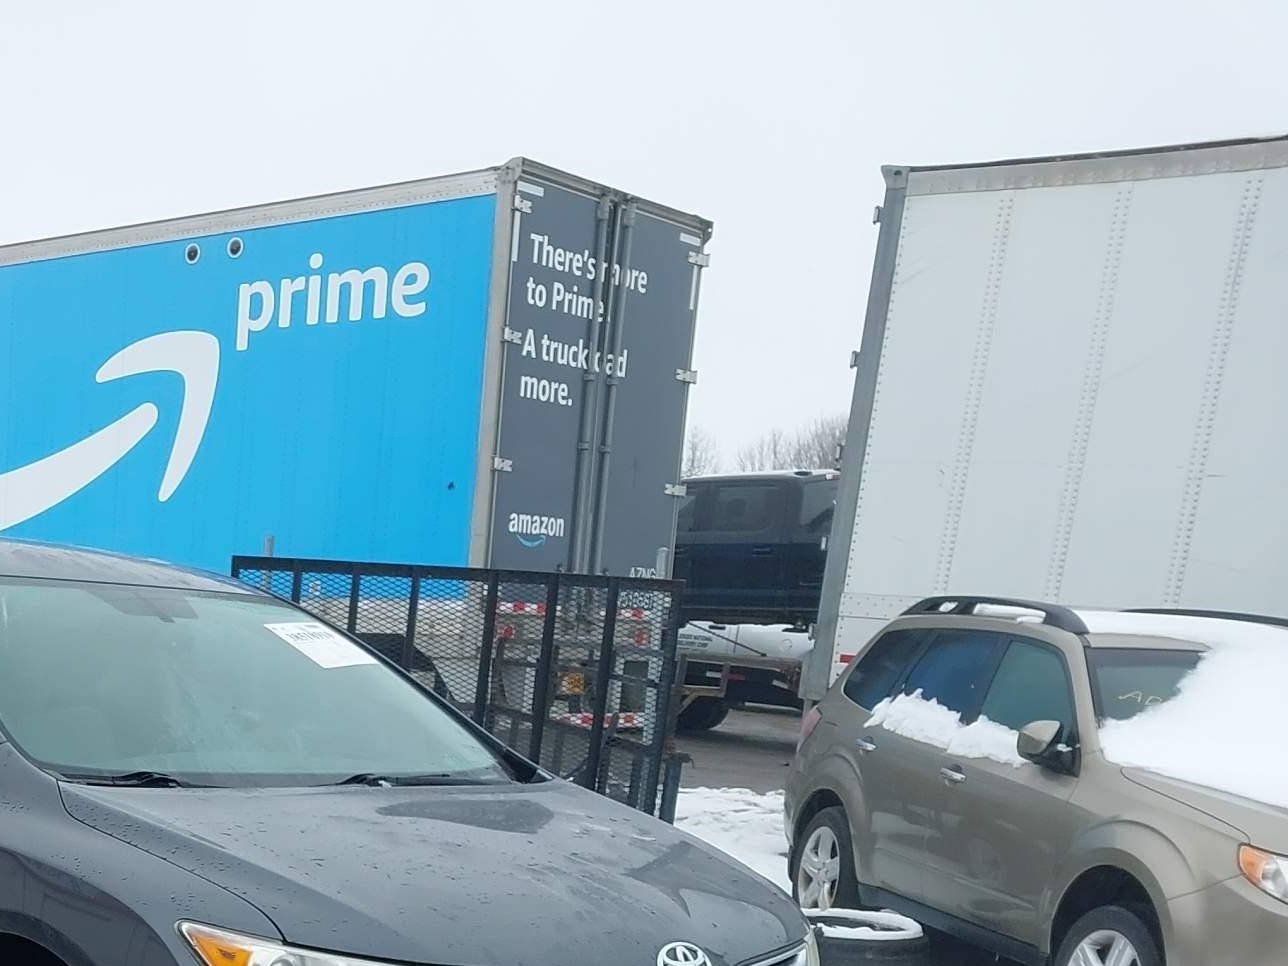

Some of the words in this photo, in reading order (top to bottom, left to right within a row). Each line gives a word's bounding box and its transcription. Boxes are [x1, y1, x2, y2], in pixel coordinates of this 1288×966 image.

[530, 233, 596, 280] There's
[601, 260, 647, 294] mre
[235, 253, 430, 351] prime
[526, 277, 547, 308] to
[521, 329, 537, 359] A
[541, 334, 628, 378] truckoad
[519, 375, 573, 407] more.
[508, 512, 565, 537] amazon
